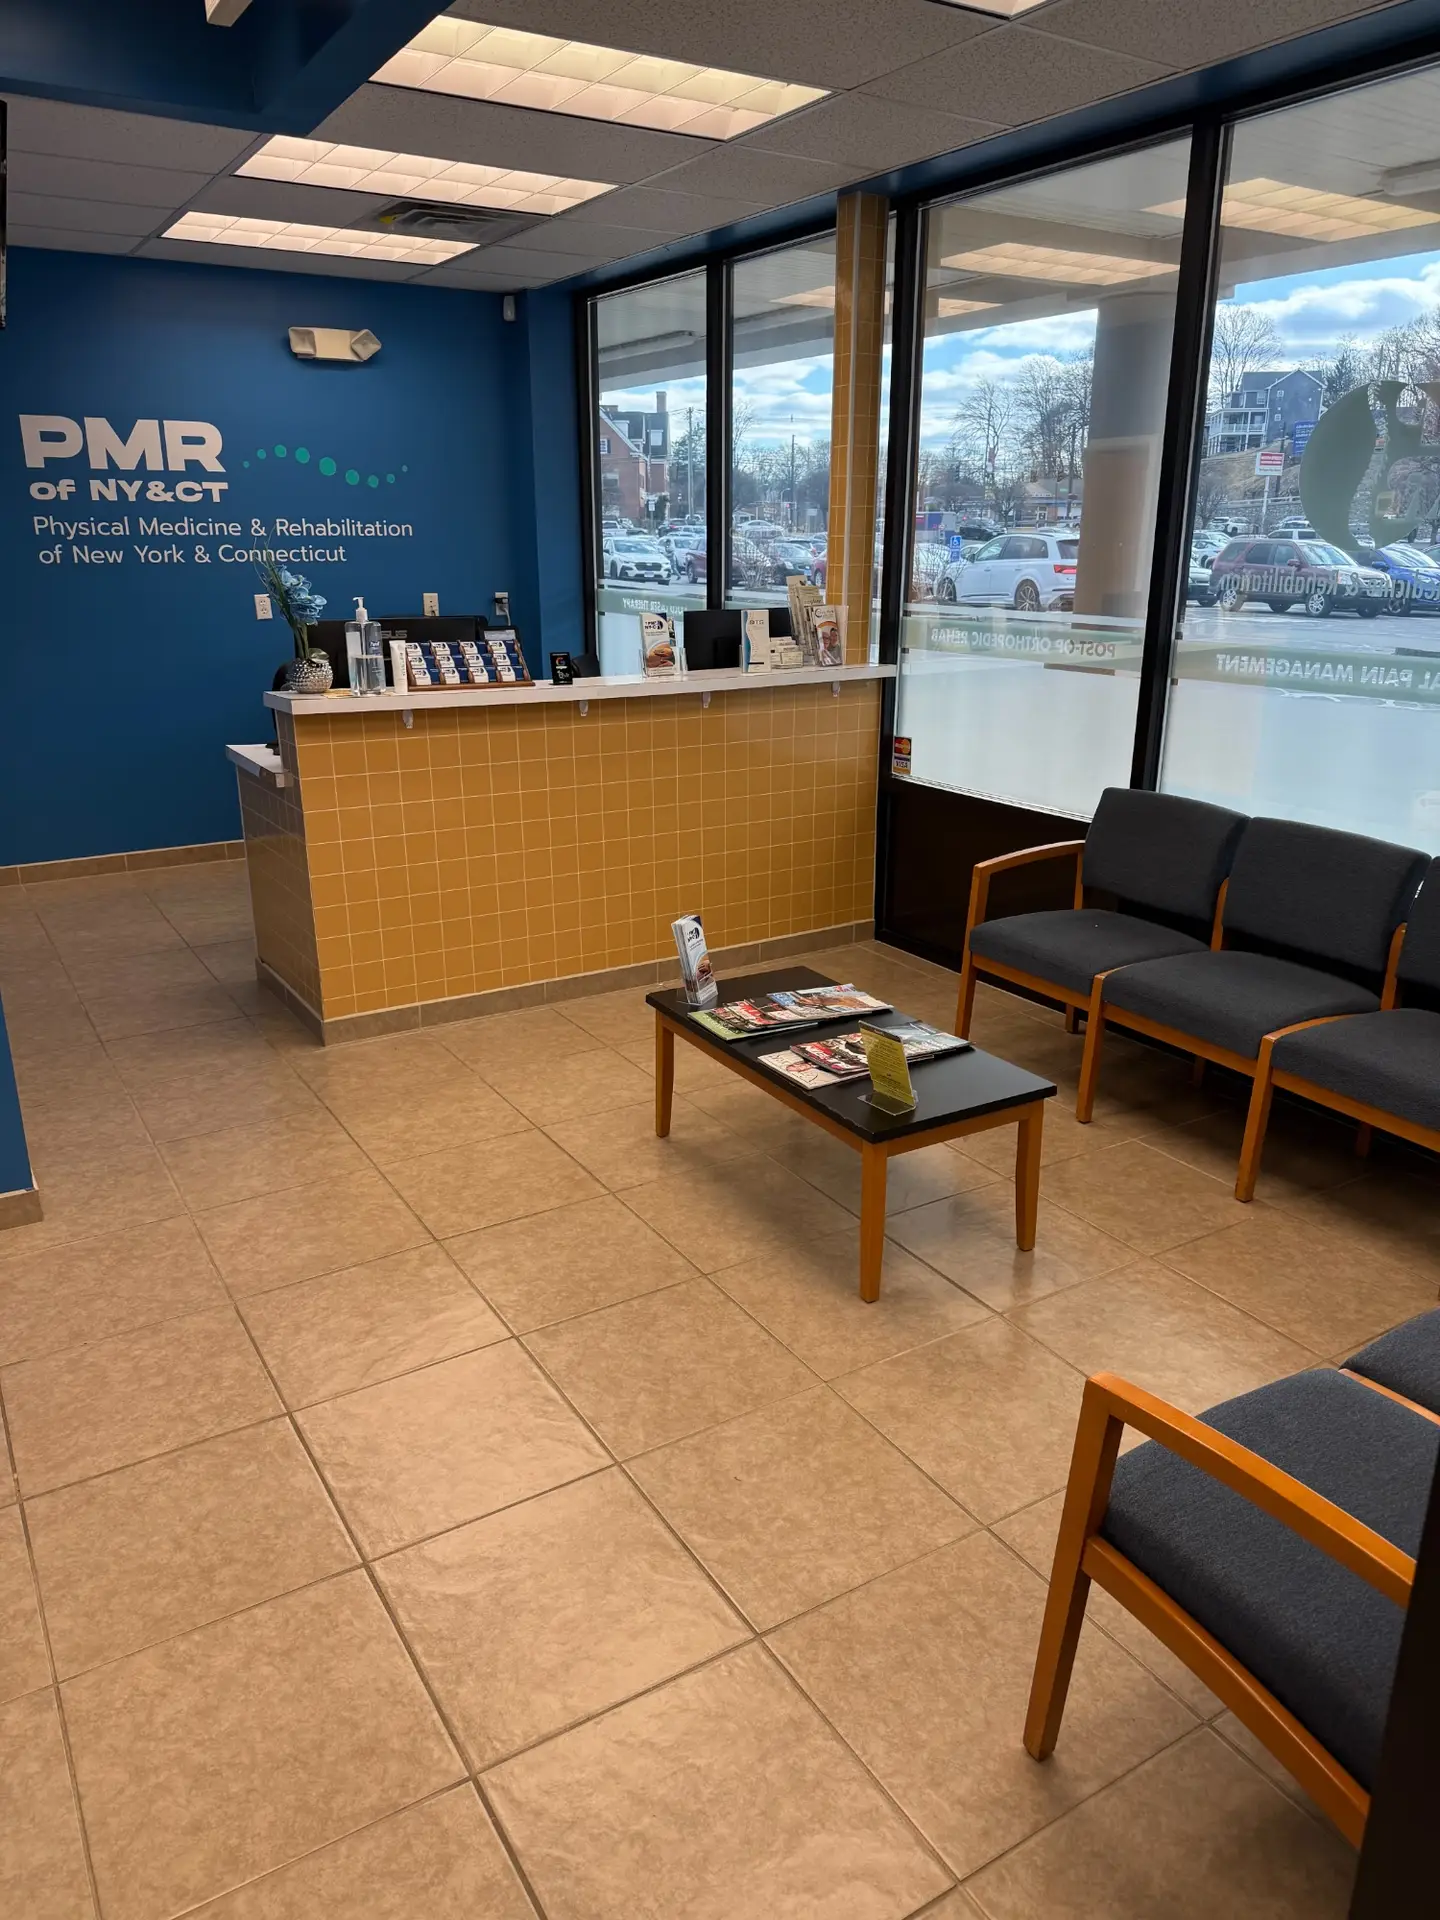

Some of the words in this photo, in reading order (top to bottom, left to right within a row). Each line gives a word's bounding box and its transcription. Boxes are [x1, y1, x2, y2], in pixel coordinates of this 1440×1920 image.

[18, 413, 226, 473] PMR
[29, 480, 76, 501] of
[90, 478, 229, 503] NY&CT
[32, 516, 130, 541] Physical
[139, 516, 242, 537] Medicine
[250, 518, 267, 537] &
[276, 518, 413, 538] Rehabilitation
[38, 545, 62, 565] of
[72, 545, 124, 564] New
[134, 545, 185, 564] York
[194, 545, 211, 563] &
[218, 544, 347, 564] Connecticut
